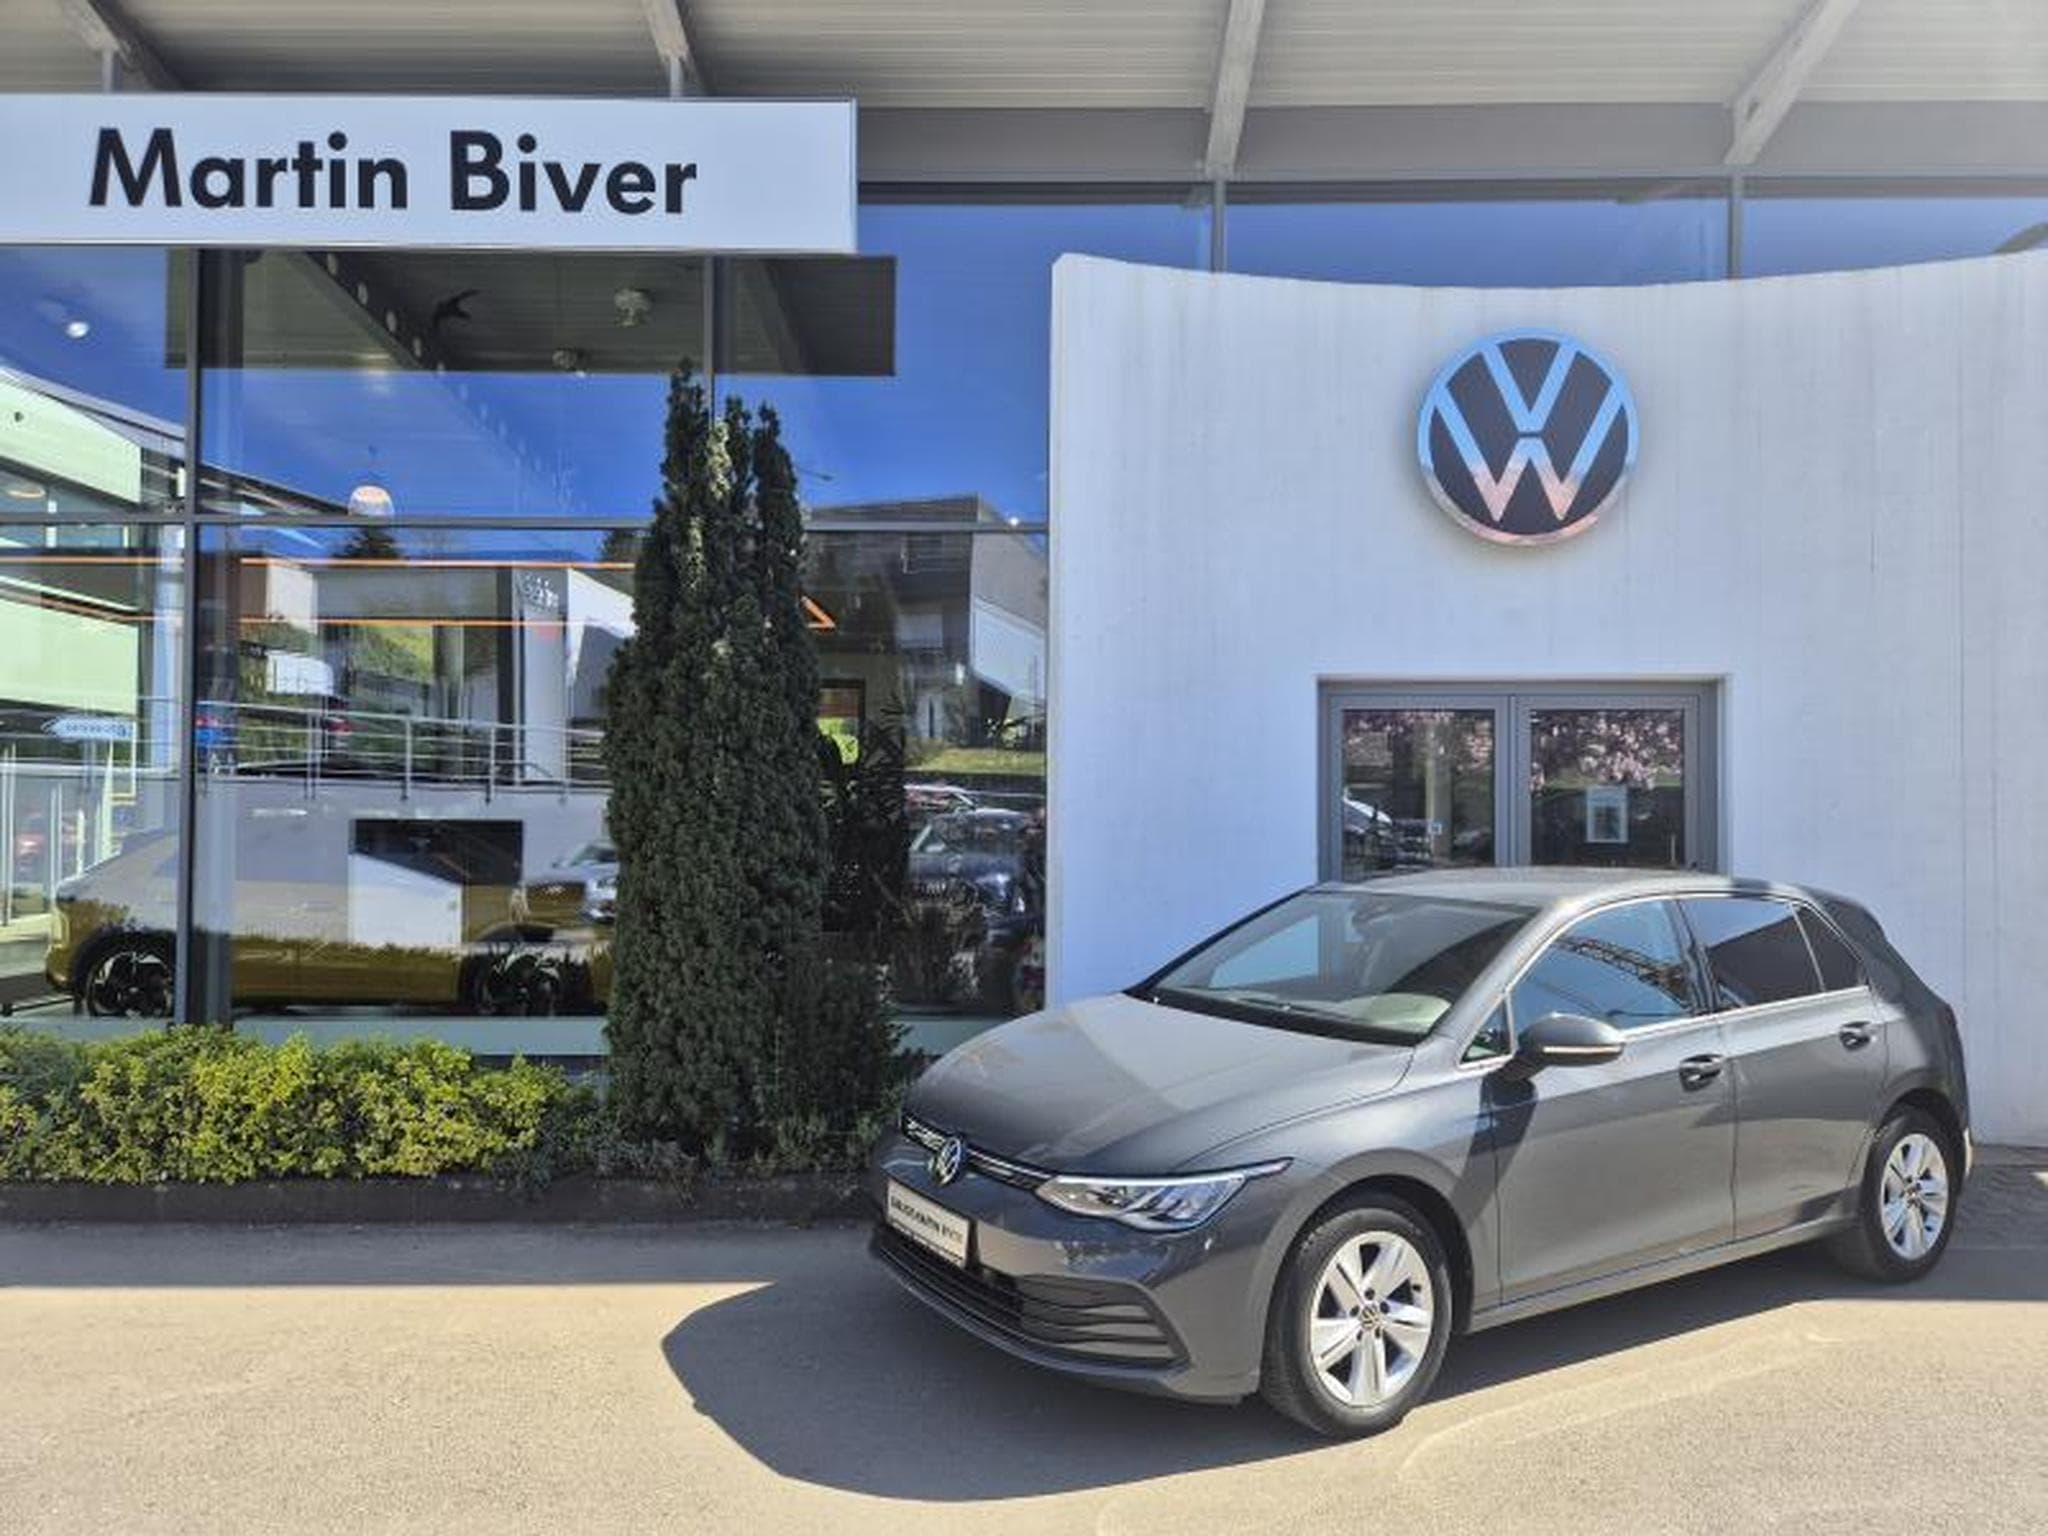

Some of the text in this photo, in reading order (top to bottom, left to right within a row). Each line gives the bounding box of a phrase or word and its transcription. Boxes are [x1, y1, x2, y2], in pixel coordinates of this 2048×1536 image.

[89, 126, 698, 214] Martin Biver
[1424, 332, 1633, 532] VW
